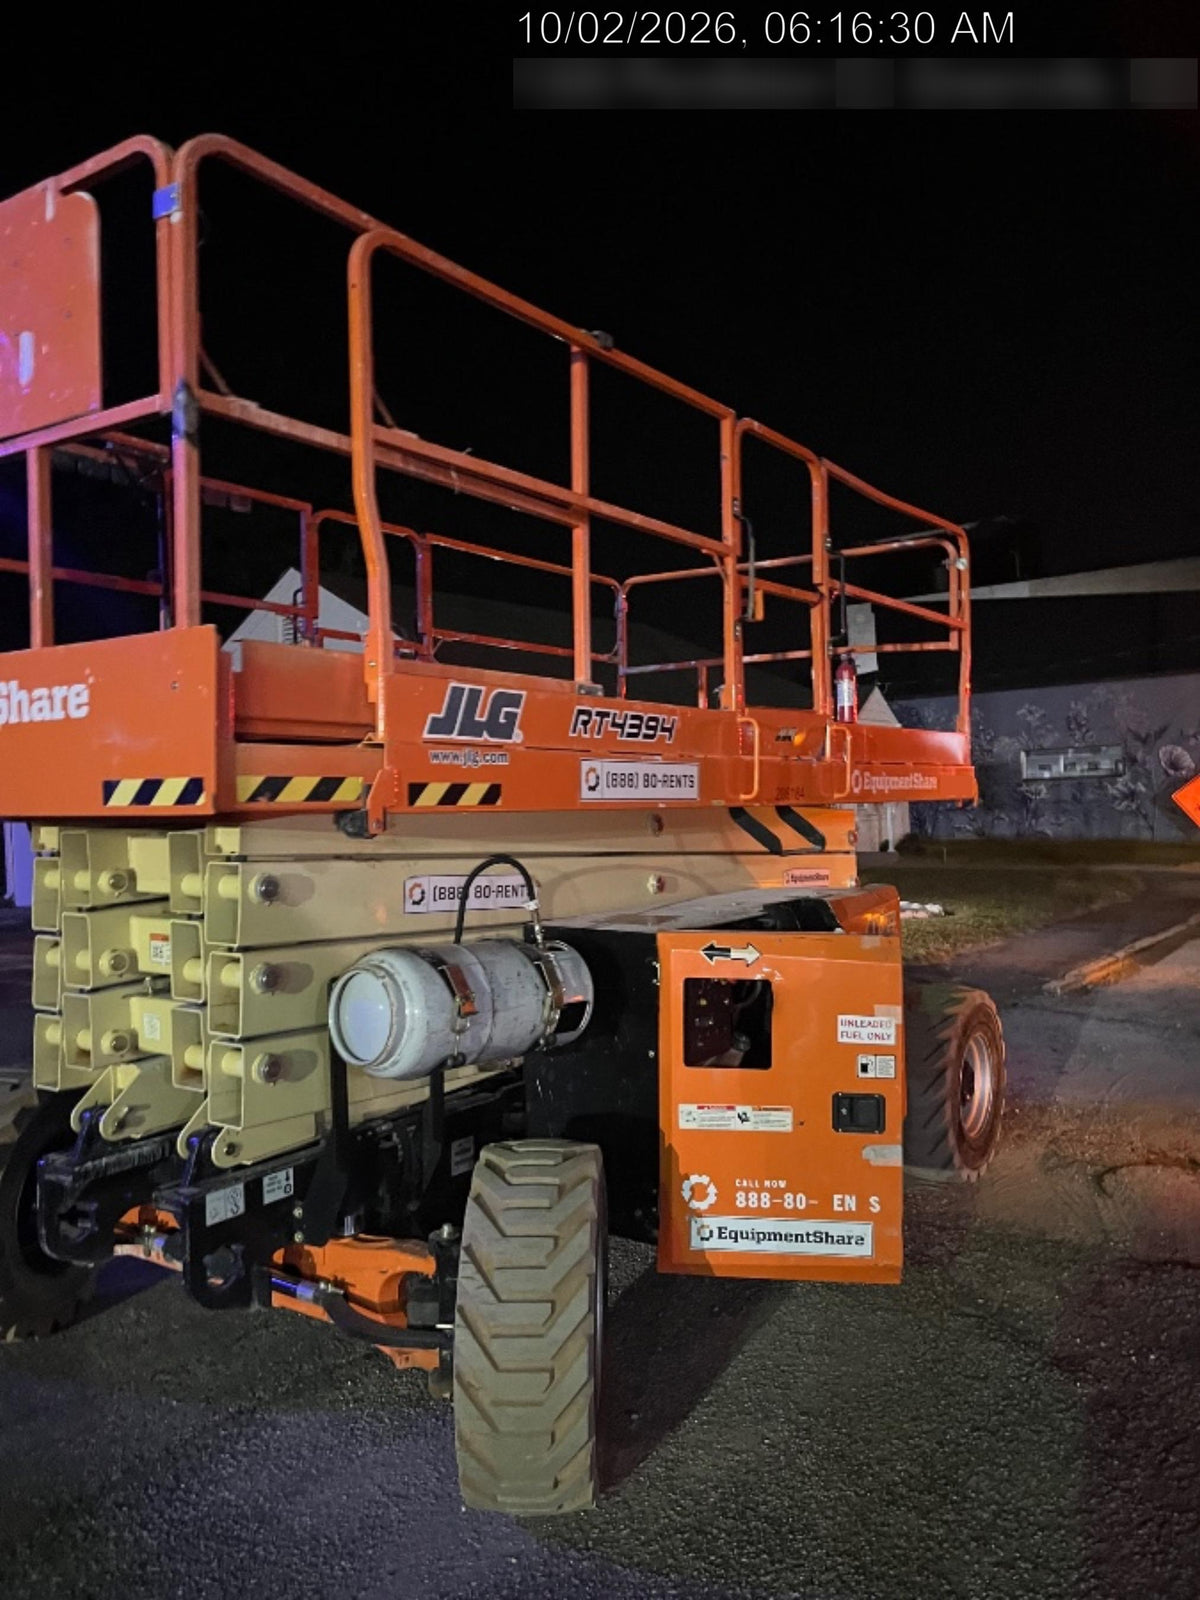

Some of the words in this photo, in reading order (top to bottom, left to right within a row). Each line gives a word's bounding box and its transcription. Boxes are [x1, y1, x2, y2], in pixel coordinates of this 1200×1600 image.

[423, 682, 526, 742] JLG
[569, 706, 677, 743] RT4394
[429, 749, 509, 768] www.jlg.com
[605, 771, 639, 789] (888)
[643, 773, 695, 788] 80-RENTS
[474, 884, 533, 899] 80-RENT
[840, 1018, 892, 1029] UNLEADED
[840, 1030, 864, 1041] FUEL
[867, 1032, 892, 1041] ONLY
[735, 1179, 760, 1189] CALL
[764, 1180, 787, 1189] NOW
[716, 1226, 866, 1246] EquipmentShare
